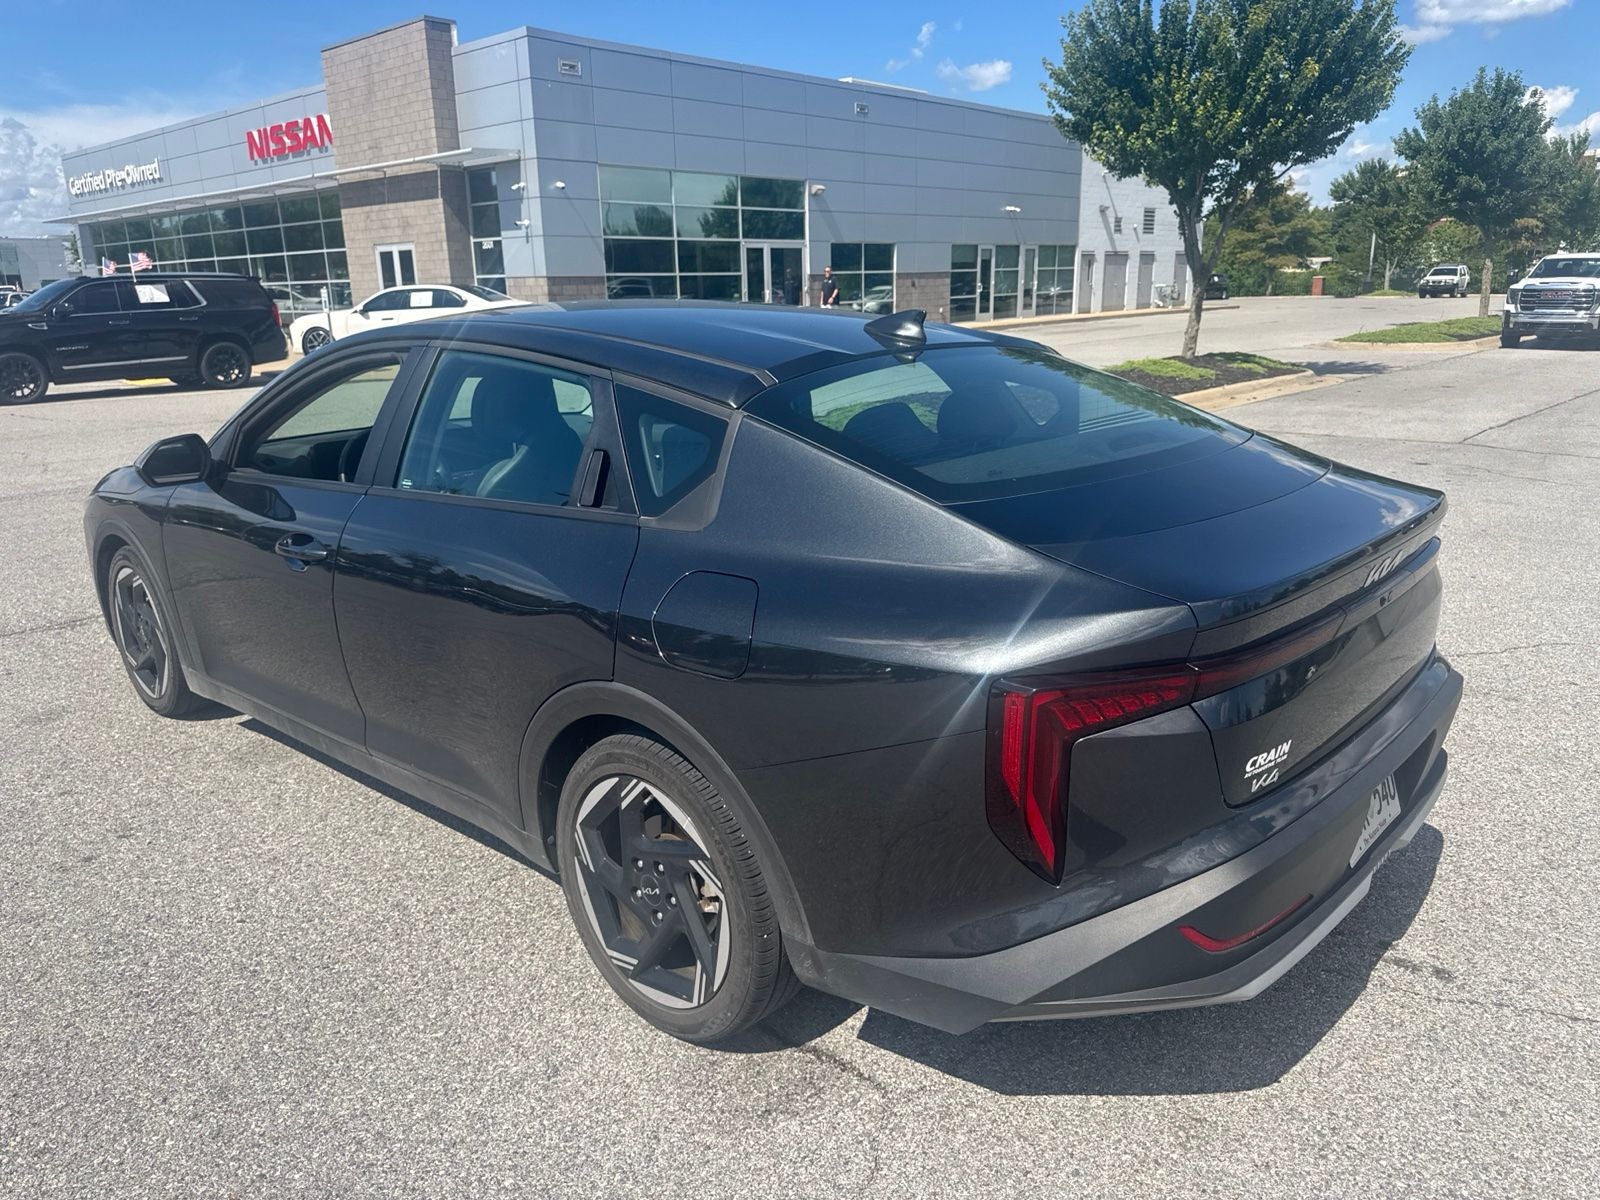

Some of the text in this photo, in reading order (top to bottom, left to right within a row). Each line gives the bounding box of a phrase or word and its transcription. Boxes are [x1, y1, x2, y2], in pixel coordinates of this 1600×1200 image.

[246, 114, 333, 161] NISSAN
[69, 158, 160, 195] Certified Pre-Owned
[1245, 739, 1292, 772] CRAIN
